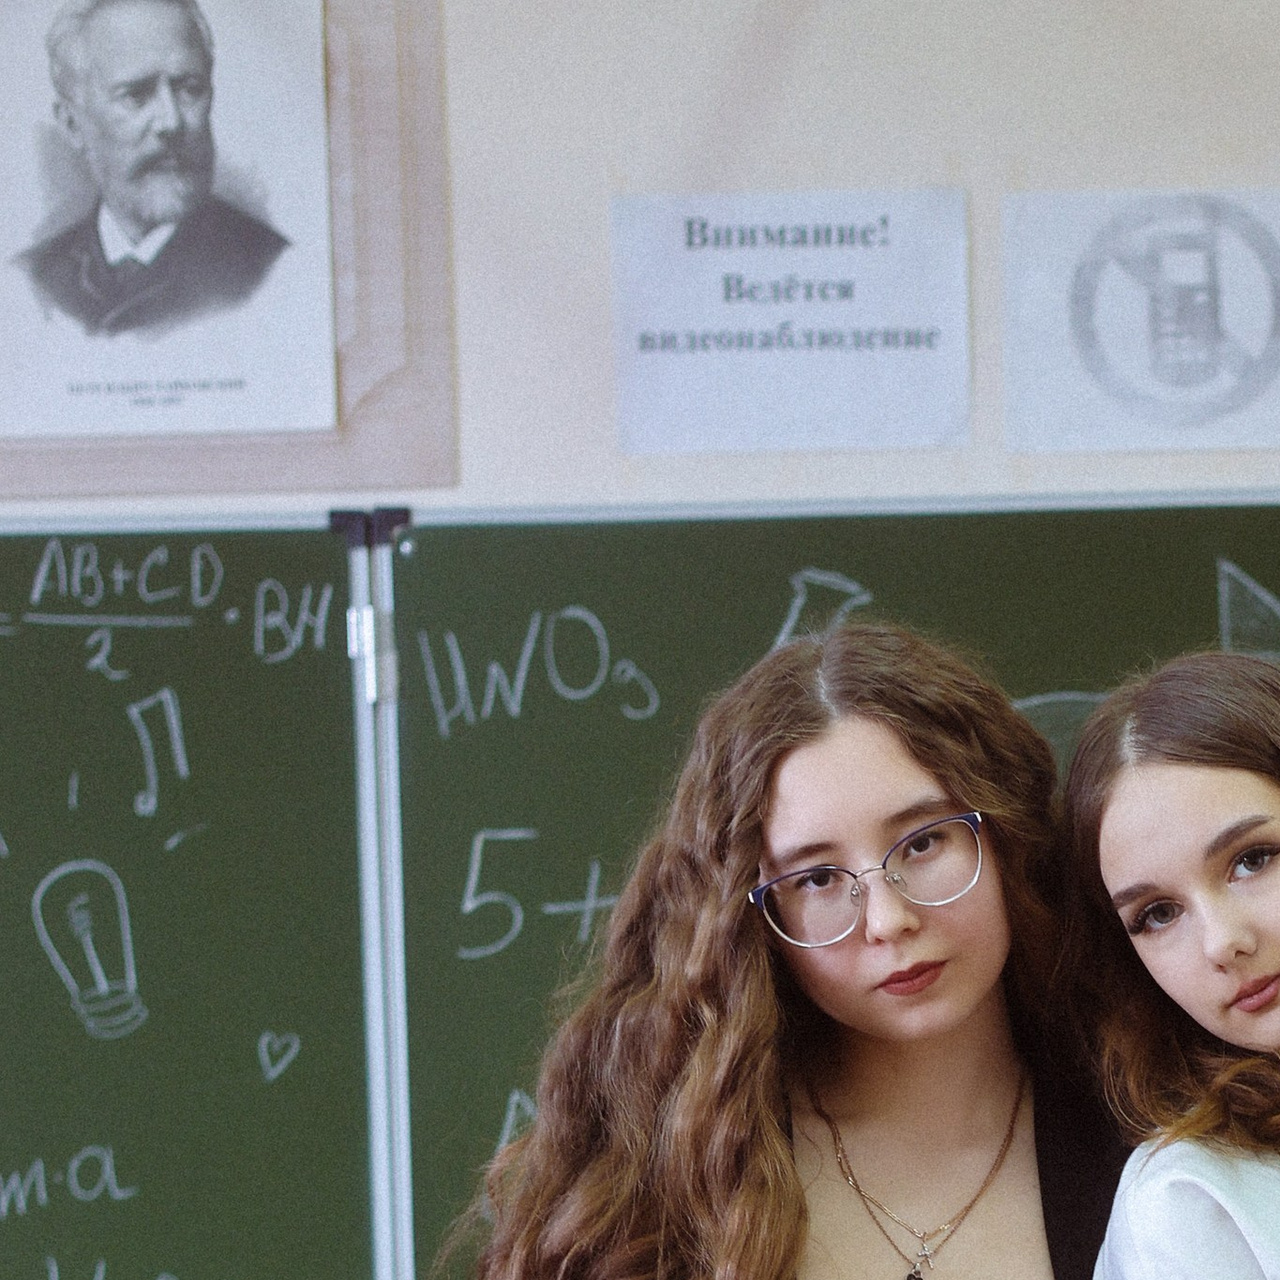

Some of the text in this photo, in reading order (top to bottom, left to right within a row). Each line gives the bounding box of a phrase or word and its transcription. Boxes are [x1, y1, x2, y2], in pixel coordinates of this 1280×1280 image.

[684, 214, 889, 249] Внимание!
[721, 271, 856, 303] Ведётся
[637, 320, 941, 353] видеонаблюдение
